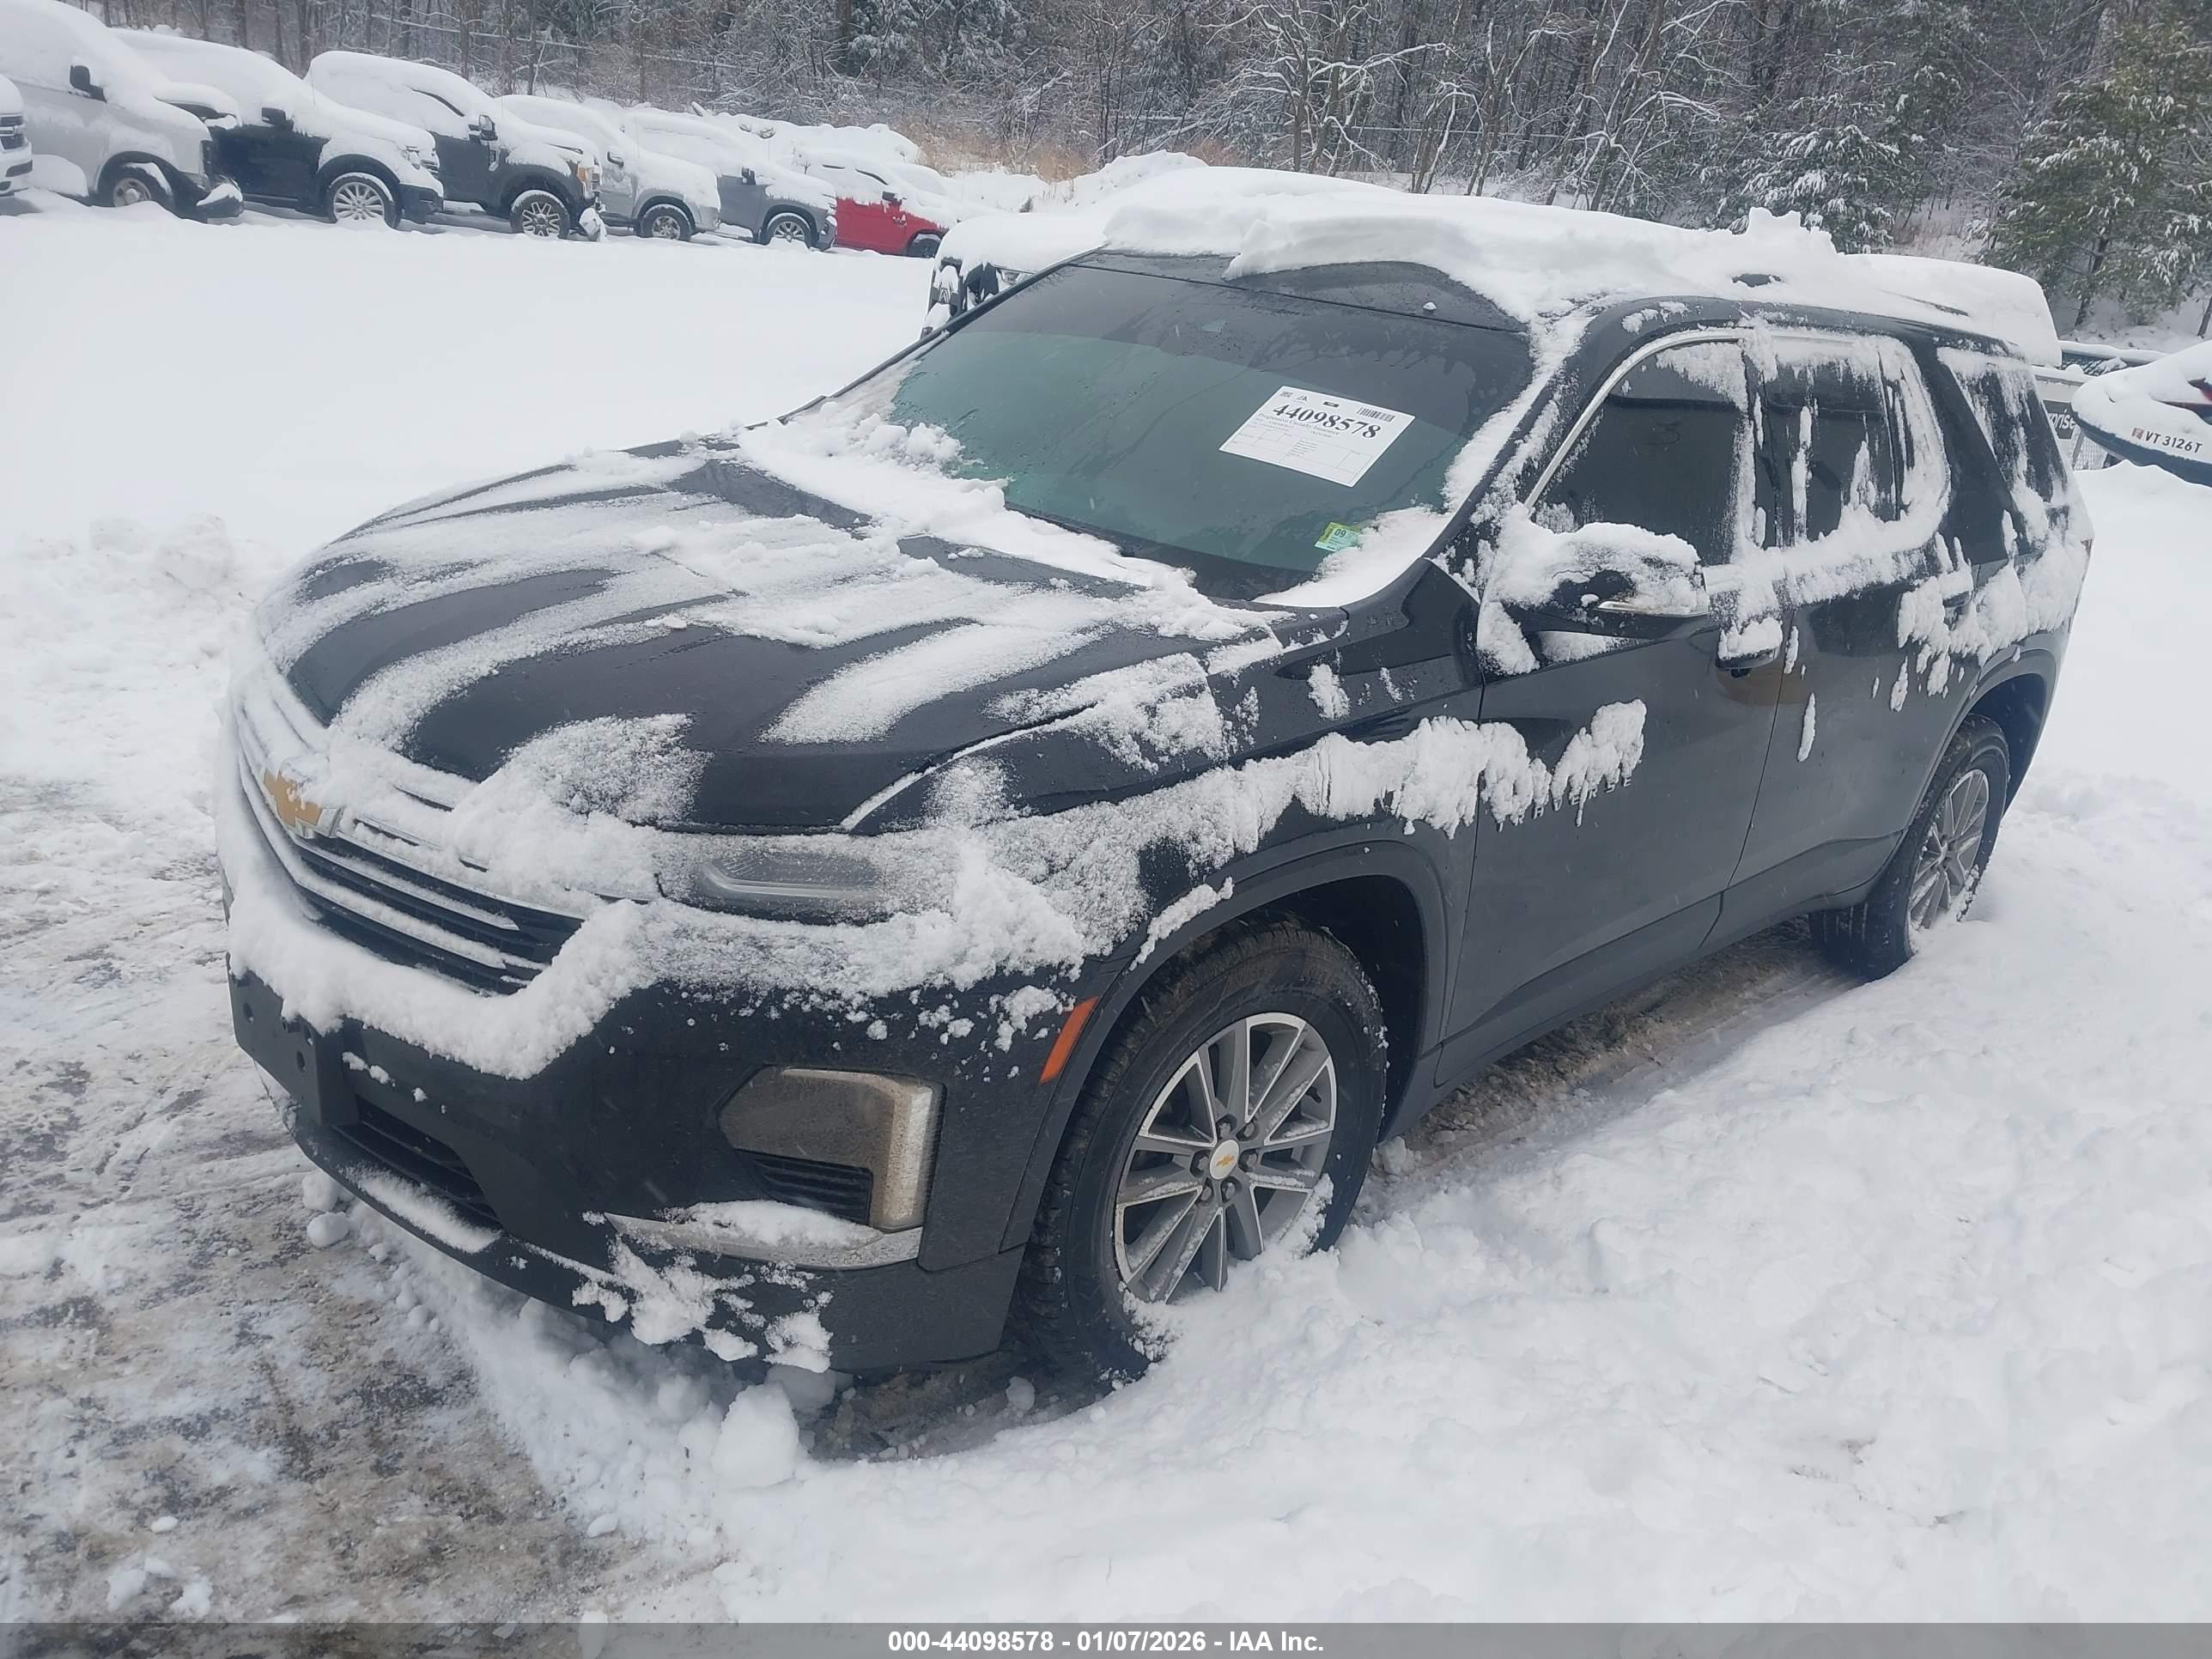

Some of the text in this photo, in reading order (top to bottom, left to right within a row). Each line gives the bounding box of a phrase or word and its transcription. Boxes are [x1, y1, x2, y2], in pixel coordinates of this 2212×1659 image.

[1273, 404, 1382, 439] 44098578
[2146, 431, 2161, 445] VT
[1334, 528, 1346, 538] 09
